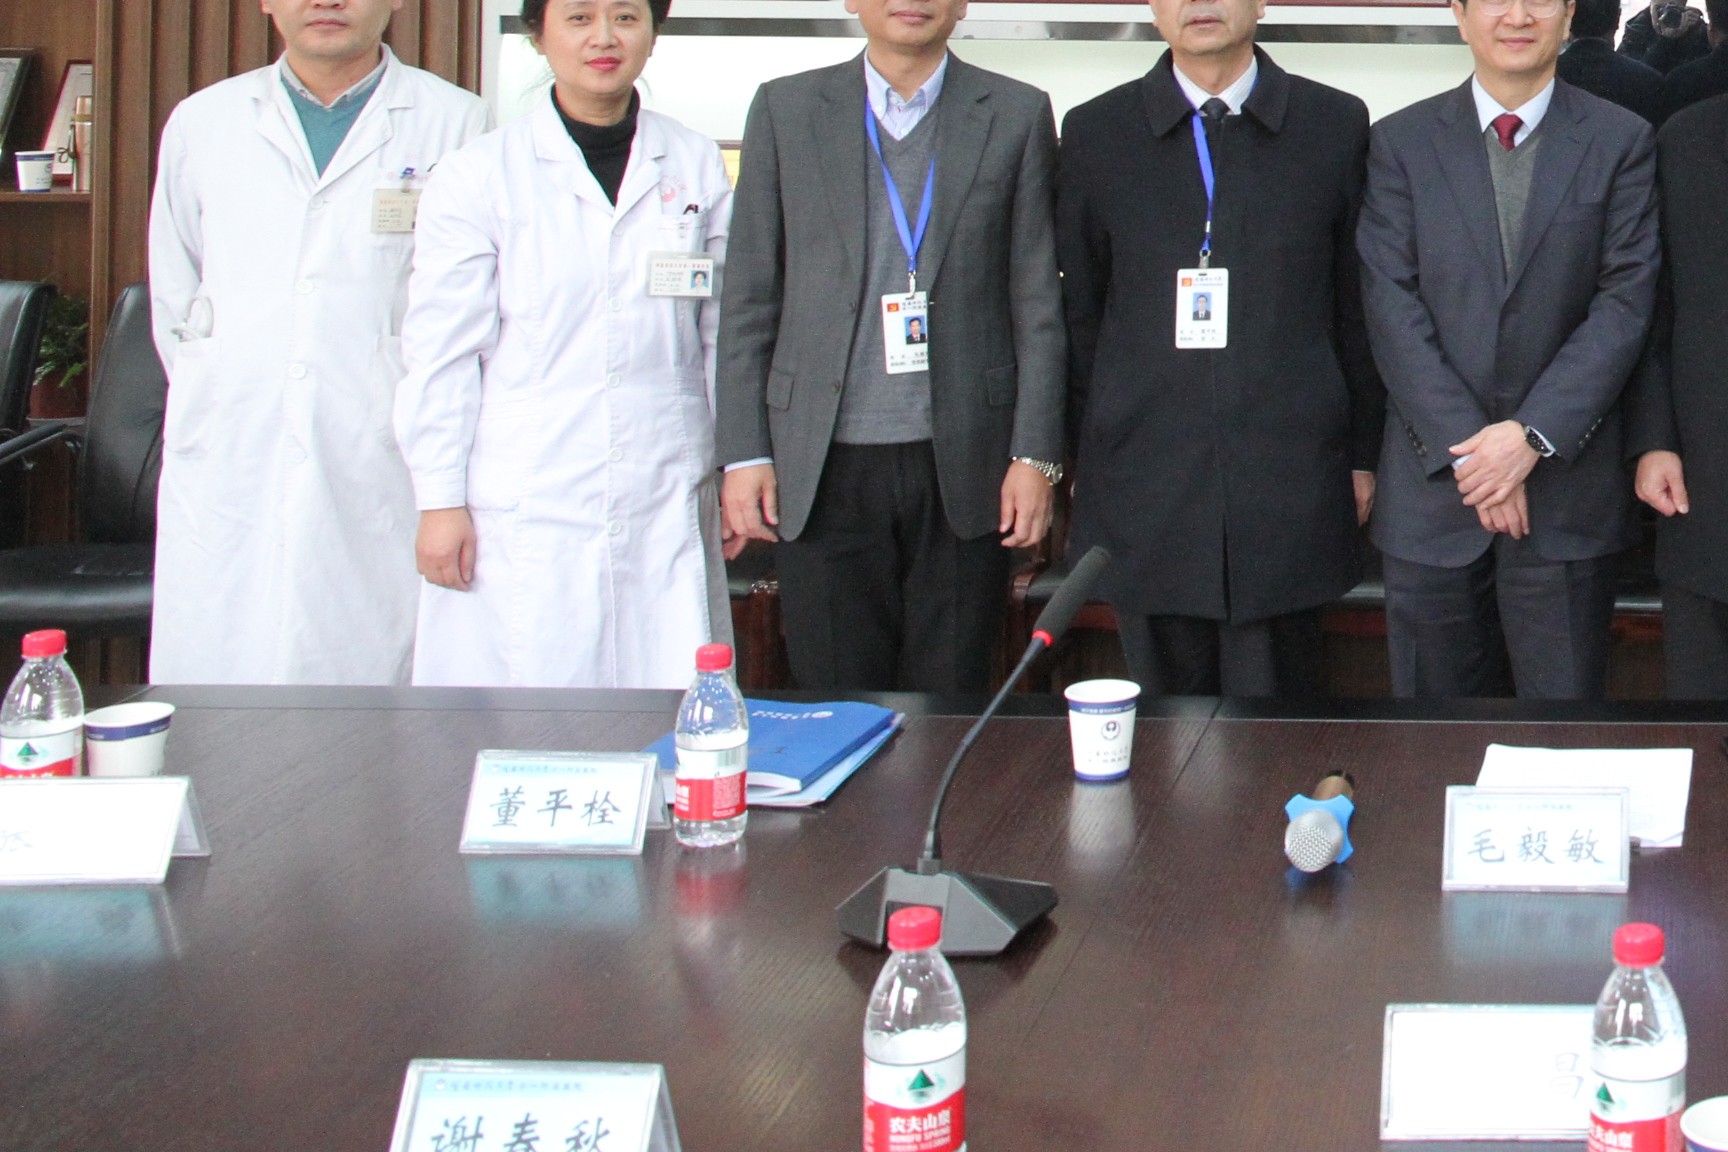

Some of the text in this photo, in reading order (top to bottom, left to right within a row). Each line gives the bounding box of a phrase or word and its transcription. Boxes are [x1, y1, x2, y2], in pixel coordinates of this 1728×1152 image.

[489, 785, 623, 829] 董平栓
[1466, 826, 1605, 866] 毛毅敏
[431, 1113, 611, 1152] 谢春秋
